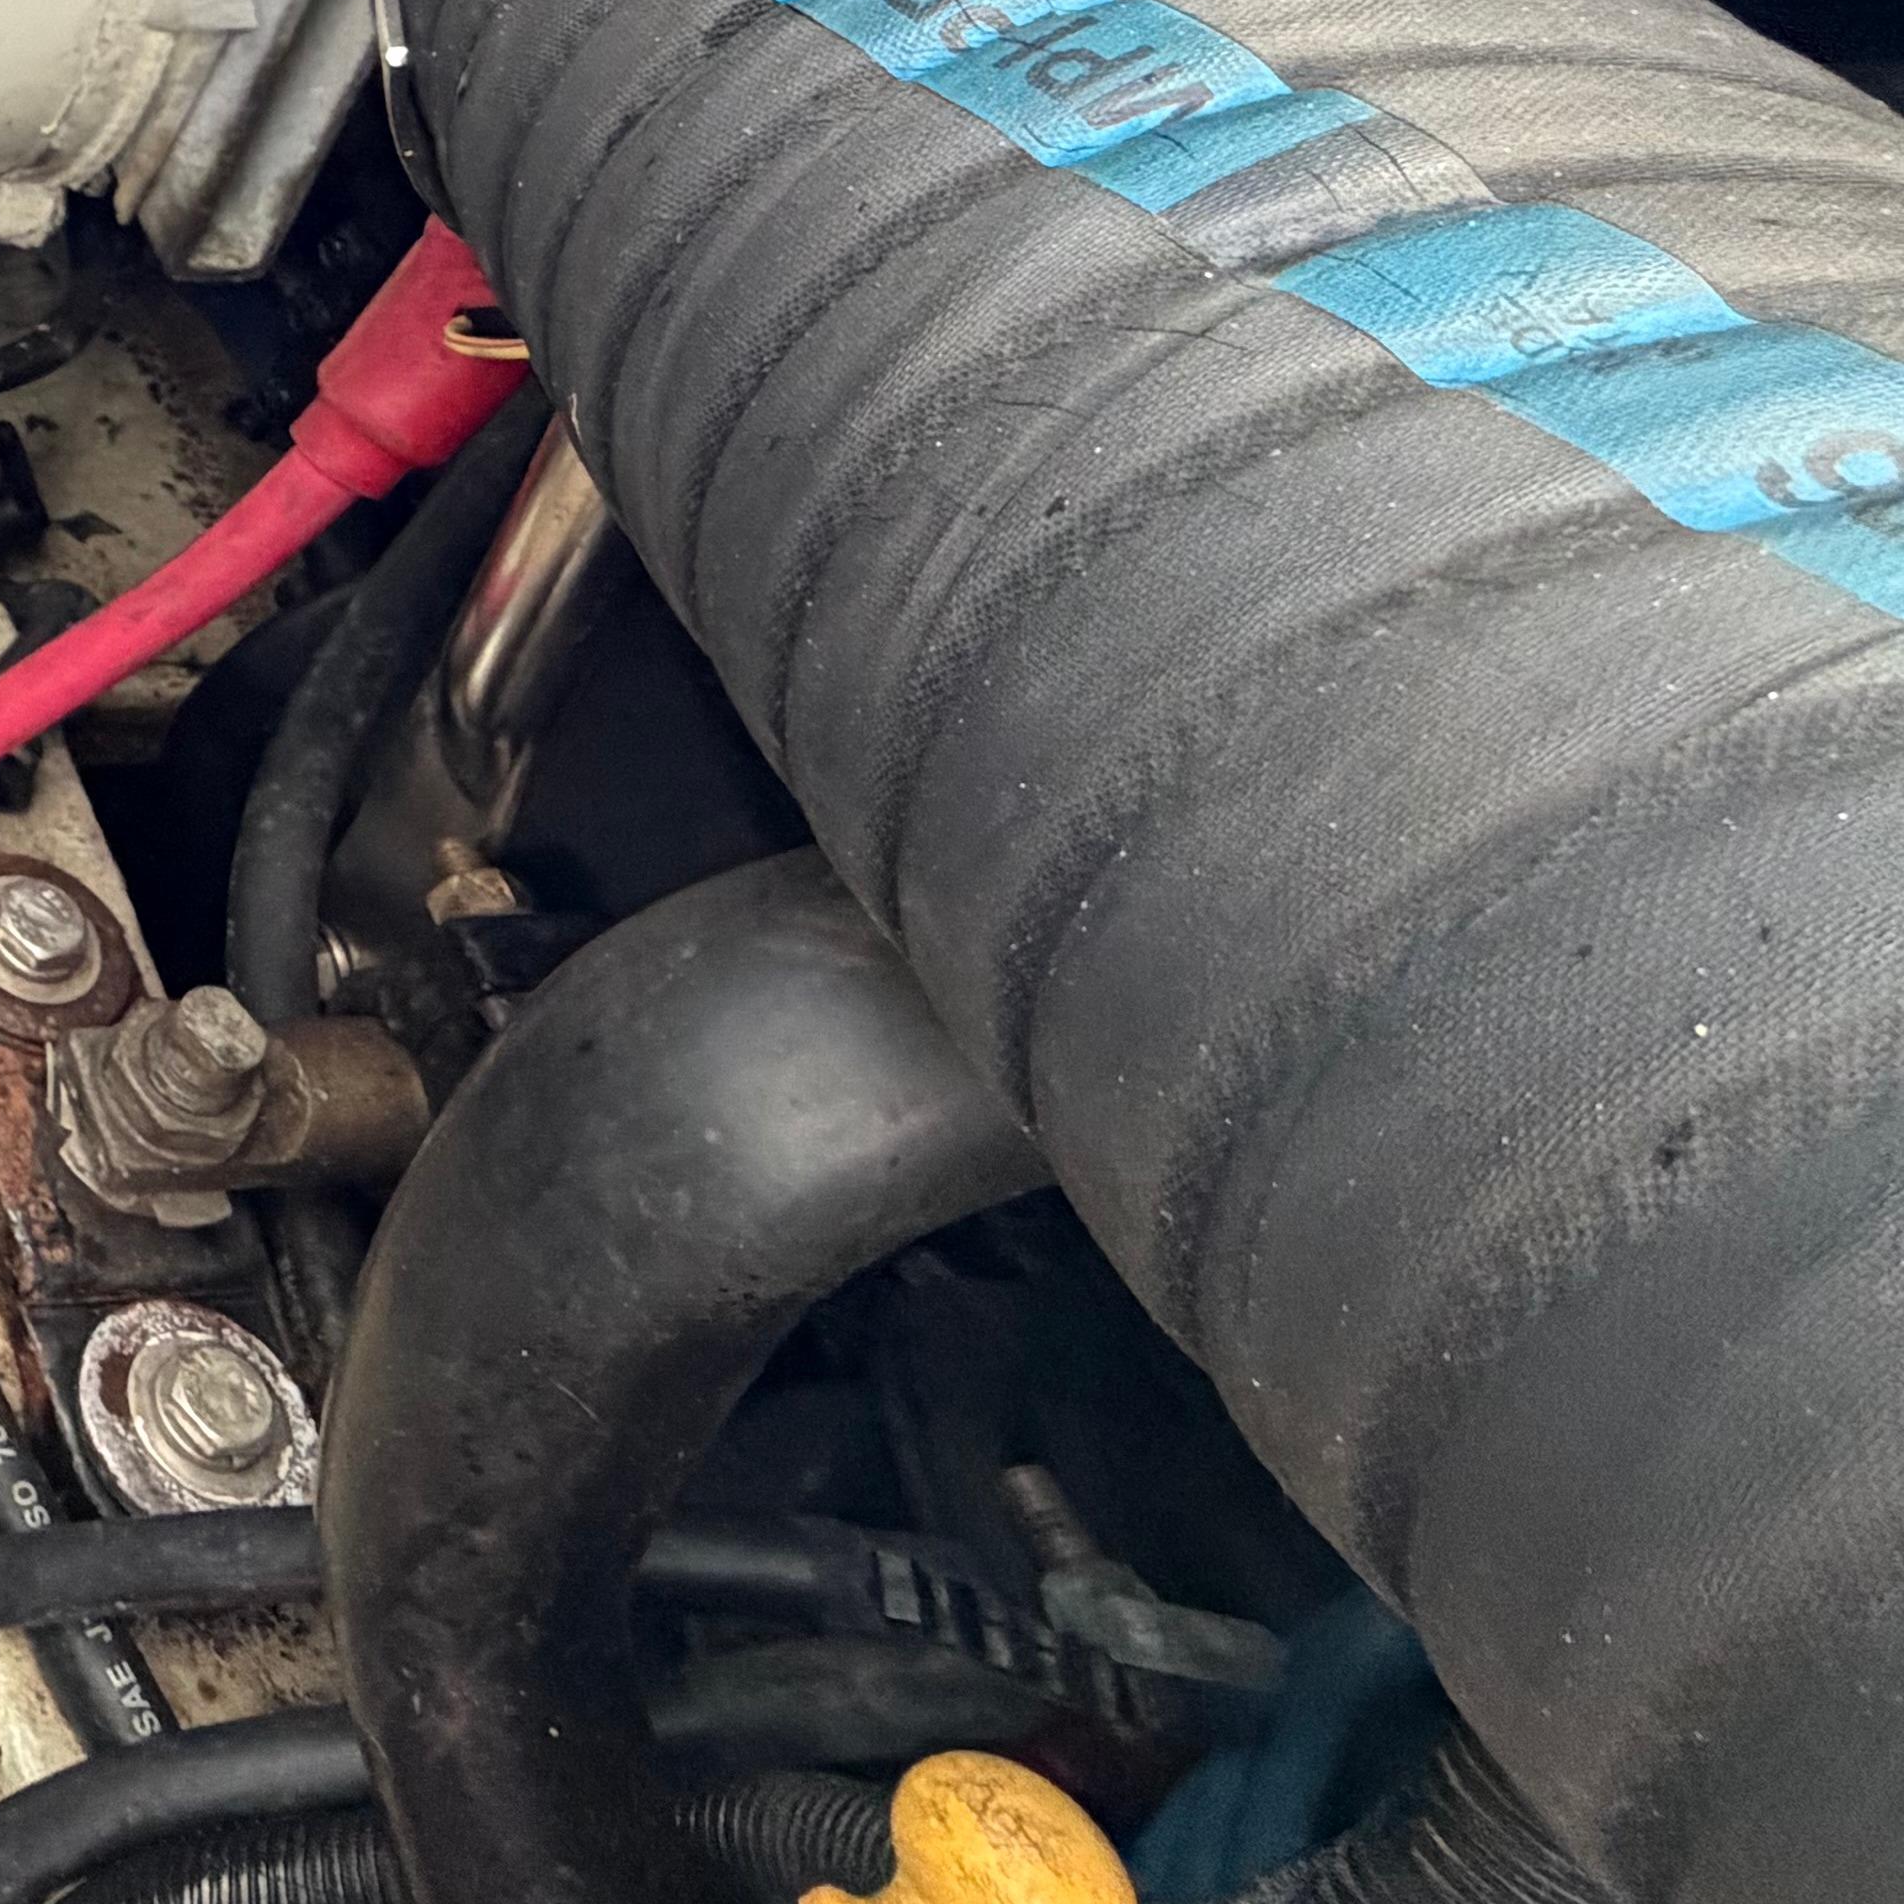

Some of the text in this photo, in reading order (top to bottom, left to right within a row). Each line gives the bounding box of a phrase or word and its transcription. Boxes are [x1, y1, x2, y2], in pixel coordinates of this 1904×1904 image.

[11, 1480, 52, 1530] SO
[85, 1616, 162, 1738] SAE J
